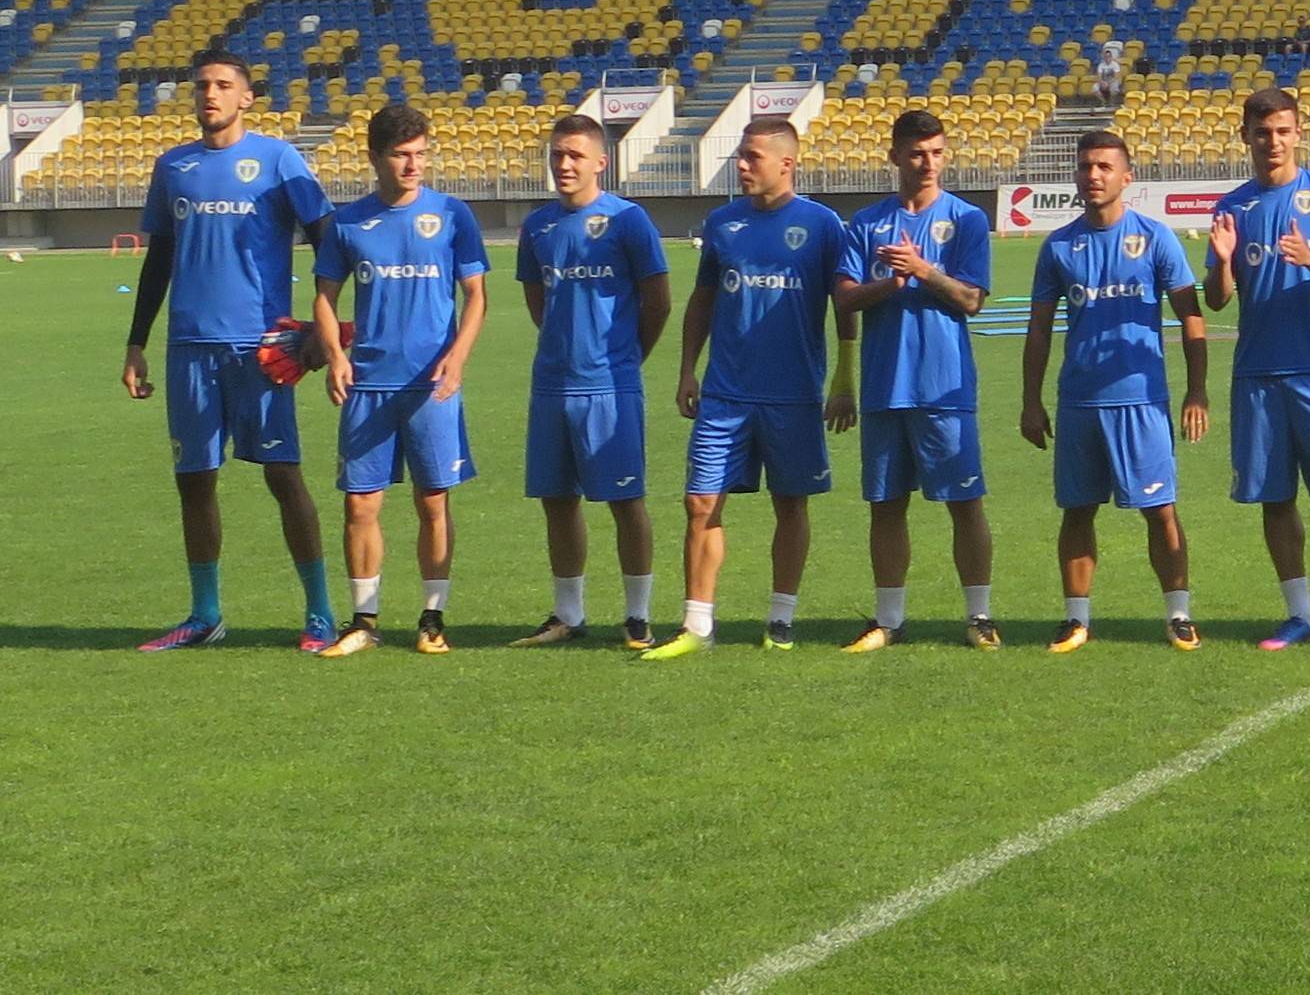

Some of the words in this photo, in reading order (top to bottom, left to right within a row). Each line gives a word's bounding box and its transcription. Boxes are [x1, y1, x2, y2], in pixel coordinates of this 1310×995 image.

[622, 101, 651, 111] VEOL
[772, 98, 800, 107] VEOL
[31, 116, 53, 125] VEO
[192, 200, 257, 215] VEOLIA
[1032, 194, 1082, 208] IMPA
[376, 264, 440, 279] VEOLIA
[557, 264, 615, 280] VEOLIA
[742, 275, 804, 291] VEOLIA
[1087, 283, 1145, 300] VEOLIA
